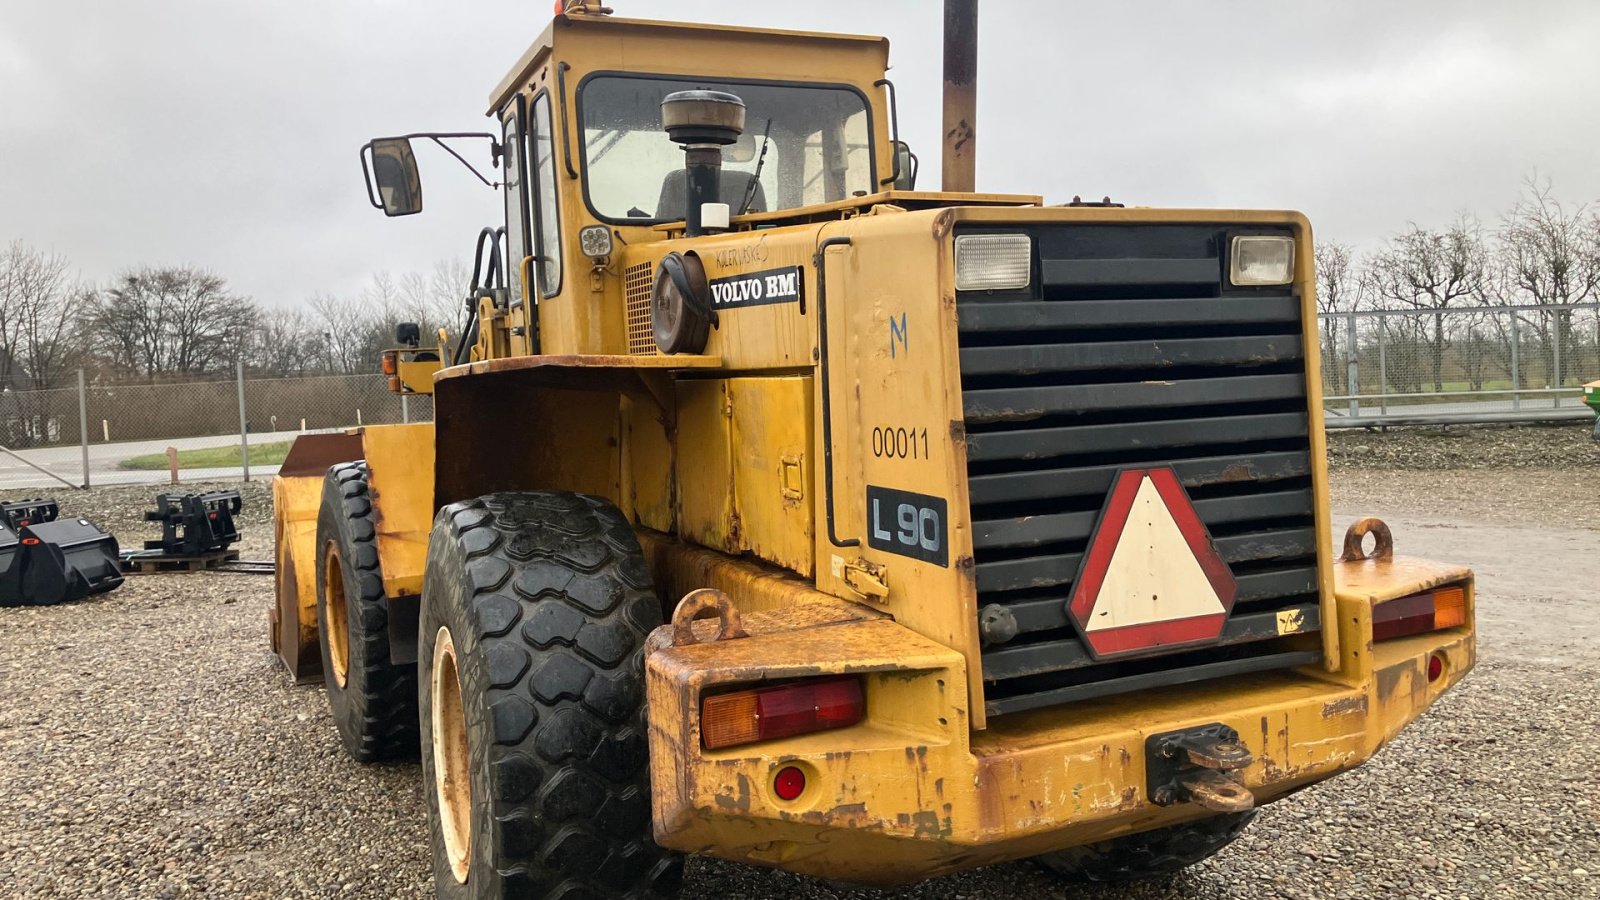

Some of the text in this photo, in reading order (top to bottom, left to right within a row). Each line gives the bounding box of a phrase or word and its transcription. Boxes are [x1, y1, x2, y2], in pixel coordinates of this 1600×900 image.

[710, 272, 797, 304] VOLVO BM
[890, 311, 908, 359] M
[872, 426, 929, 460] 00011
[873, 498, 940, 552] L 90
